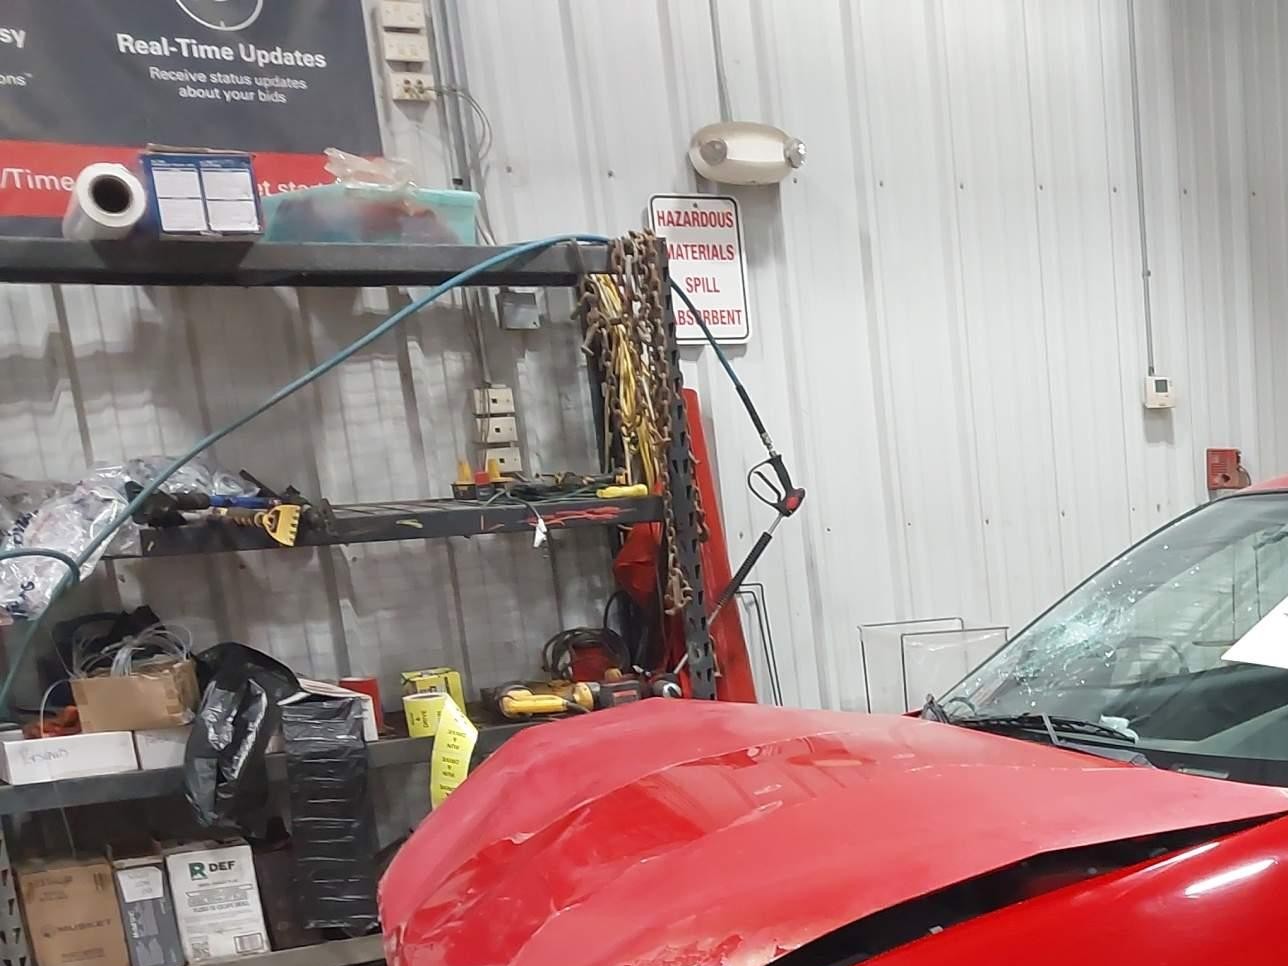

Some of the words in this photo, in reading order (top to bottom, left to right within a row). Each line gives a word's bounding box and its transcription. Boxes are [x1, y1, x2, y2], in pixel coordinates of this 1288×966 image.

[116, 33, 235, 61] Real-Time
[238, 43, 328, 68] Updates
[149, 66, 207, 83] Receive
[209, 71, 251, 86] status
[254, 76, 308, 90] updates
[179, 85, 221, 99] about
[223, 89, 255, 102] your
[258, 89, 288, 104] bids
[656, 210, 734, 228] HAZARDOUS
[667, 244, 735, 261] MATERIALS
[685, 277, 721, 293] SPILL
[208, 861, 236, 873] DEF
